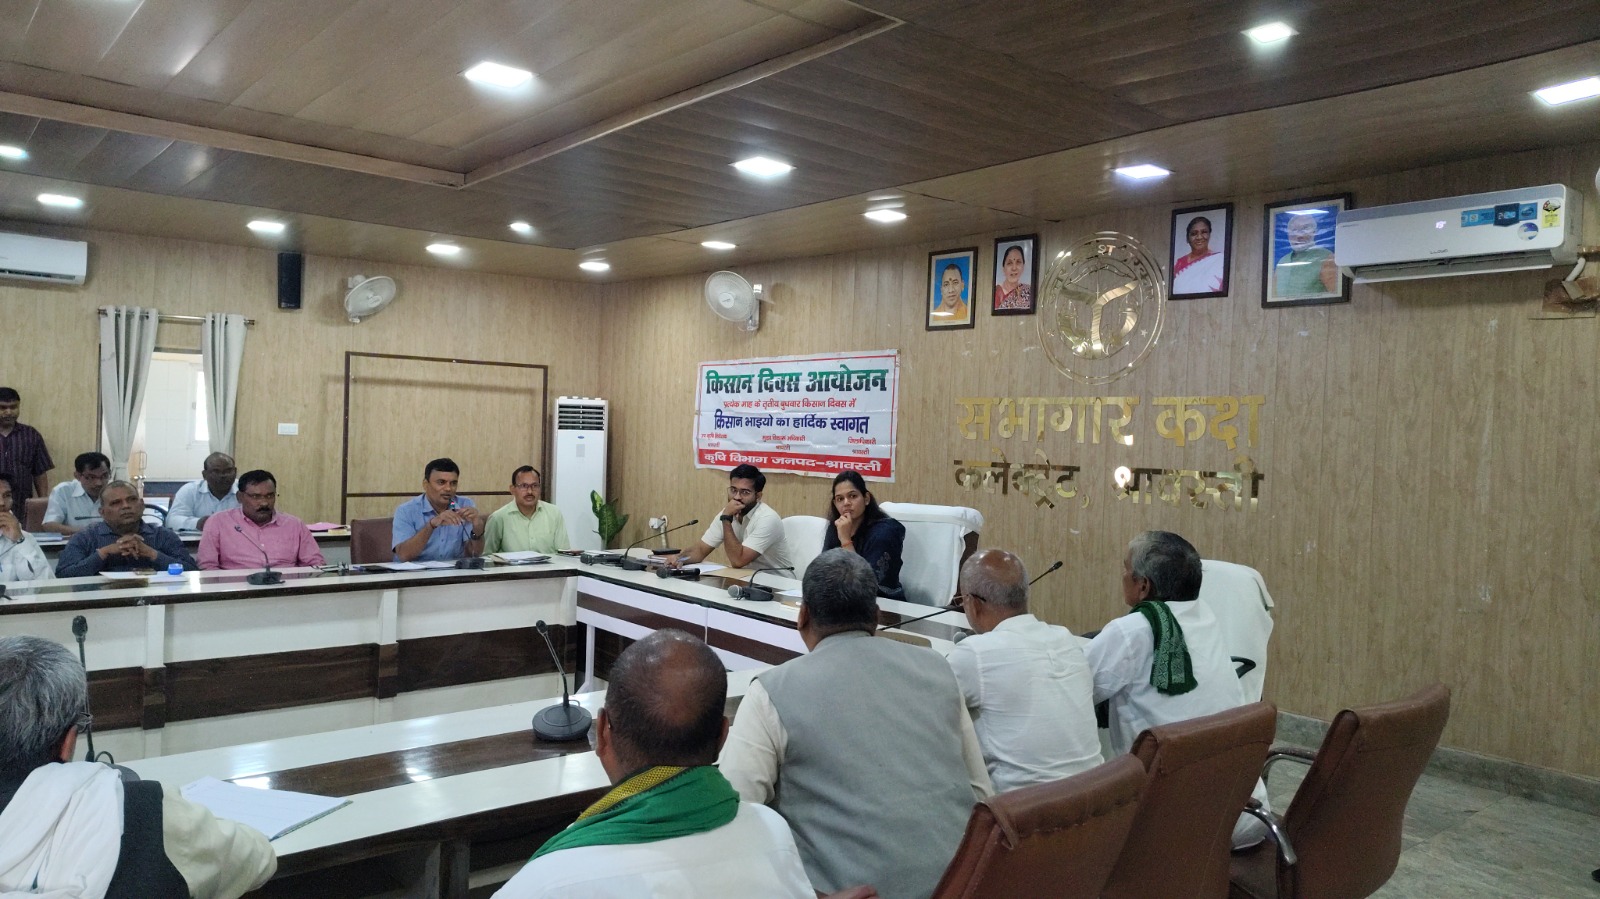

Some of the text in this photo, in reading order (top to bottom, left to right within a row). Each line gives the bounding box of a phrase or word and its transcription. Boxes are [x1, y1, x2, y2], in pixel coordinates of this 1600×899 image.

[705, 364, 889, 395] किसान दिवस आयोजन
[741, 400, 753, 408] माह
[754, 399, 761, 408] के
[762, 398, 779, 410] तृतीय
[780, 400, 800, 411] बुधवार
[802, 398, 826, 408] किसान
[827, 397, 848, 408] दिवस
[848, 397, 857, 408] में
[714, 408, 743, 430] किसान
[775, 416, 790, 427] का
[792, 413, 828, 429] हार्दिक
[830, 416, 870, 434] स्वागत
[954, 396, 1140, 446] सभागार
[704, 452, 883, 472] कृषि विभाग जनपद-श्रावस्ती
